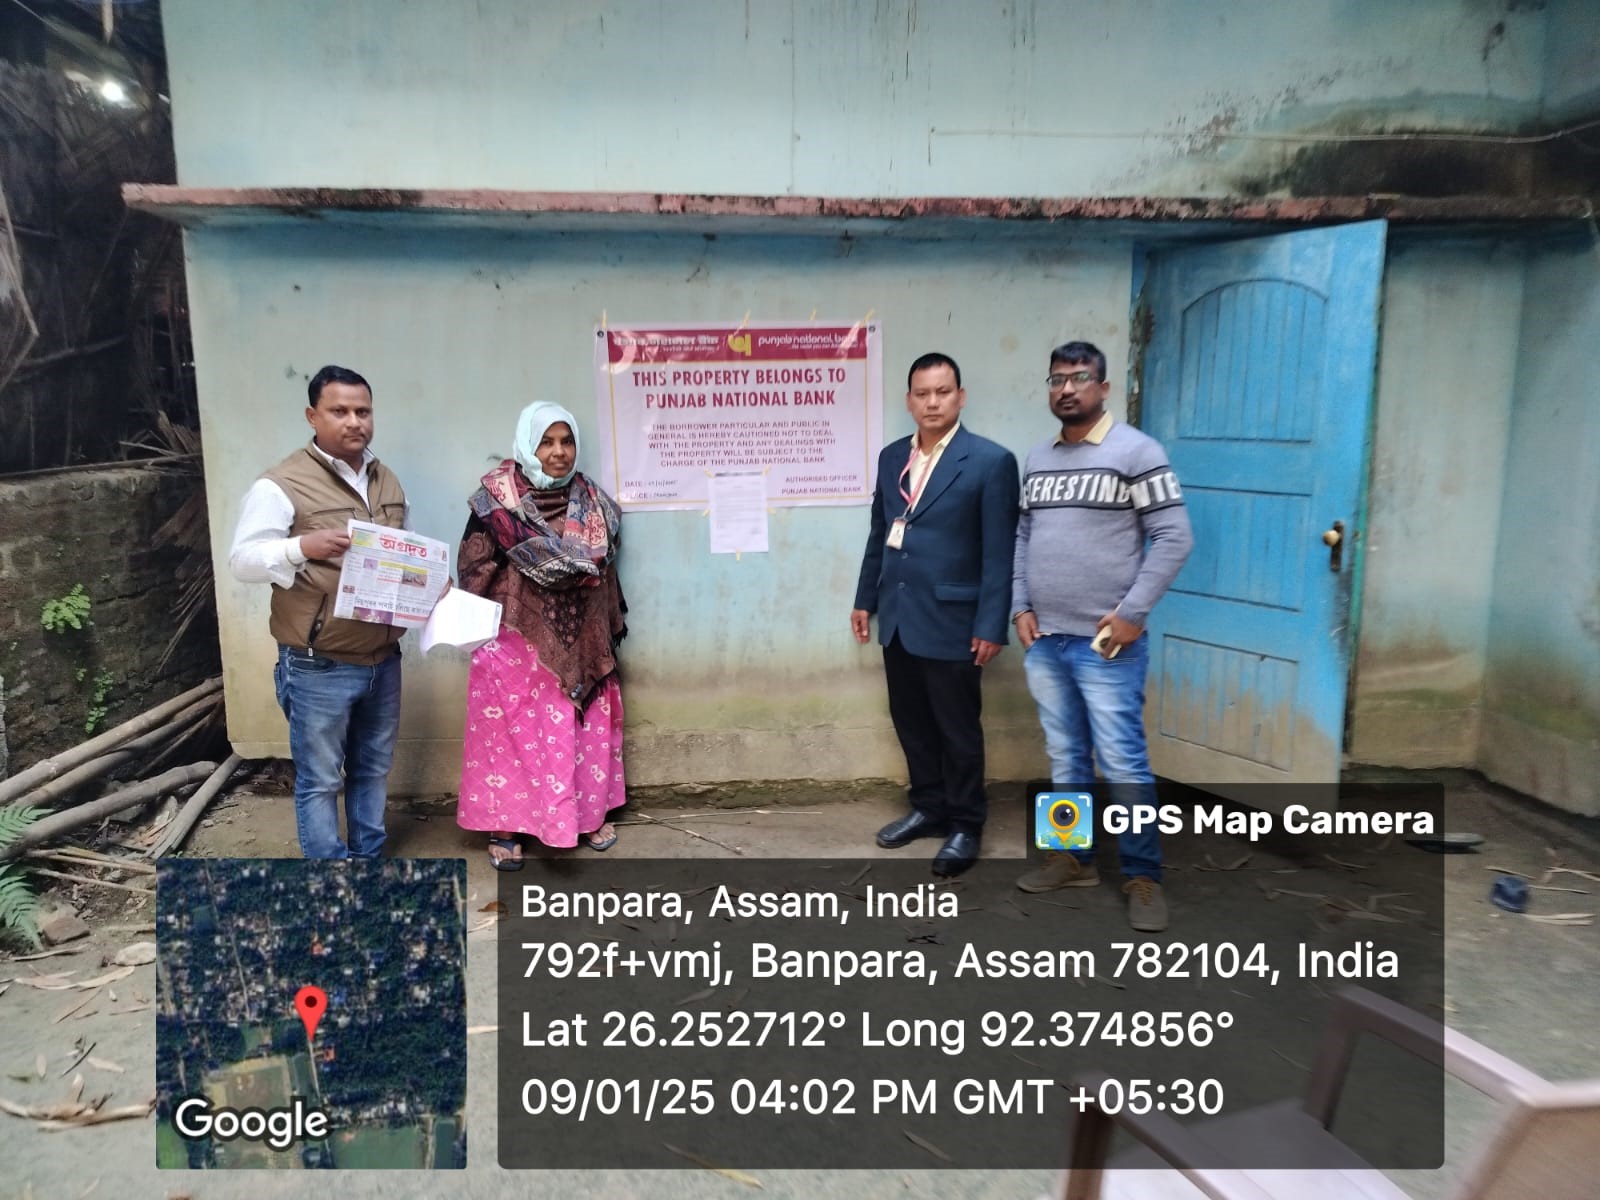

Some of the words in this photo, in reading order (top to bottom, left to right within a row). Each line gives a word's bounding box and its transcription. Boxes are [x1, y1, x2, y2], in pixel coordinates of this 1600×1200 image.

[758, 333, 792, 348] punjab
[793, 332, 833, 345] national
[633, 371, 667, 387] THIS
[673, 369, 750, 386] PROPERTY
[756, 368, 822, 385] BELONGS
[828, 367, 846, 384] TO
[646, 393, 707, 409] PUNJAB
[713, 391, 788, 408] NATIONAL
[794, 390, 836, 406] BANK
[669, 423, 718, 431] BORROWER
[720, 421, 770, 431] PARTICULAR
[772, 420, 789, 429] AND
[791, 420, 820, 429] PUBLIC
[822, 419, 831, 428] IN
[648, 432, 687, 441] GENERAL
[689, 432, 697, 440] IS
[698, 431, 732, 440] HEREBY
[733, 430, 780, 439] CAUTIONED
[782, 430, 798, 438] NOT
[801, 429, 812, 437] TO
[813, 429, 834, 437] DEAL
[648, 441, 670, 449] WITH
[673, 440, 689, 449] THE
[691, 440, 735, 449] PROPERTY
[736, 440, 754, 448] AND
[756, 439, 772, 447] ANY
[774, 438, 814, 447] DEALINGS
[816, 437, 836, 446] WITH
[660, 450, 676, 459] THE
[678, 448, 721, 458] PROPERTY
[723, 448, 742, 457] WILL
[744, 448, 754, 456] BE
[757, 447, 793, 456] SUBJECT
[796, 447, 807, 455] TO
[808, 446, 824, 455] THE
[660, 458, 695, 467] CHARGE
[696, 458, 707, 466] OF
[710, 458, 726, 466] THE
[728, 457, 760, 465] PUNJAB
[762, 455, 801, 465] NATIONAL
[803, 455, 826, 464] BANK
